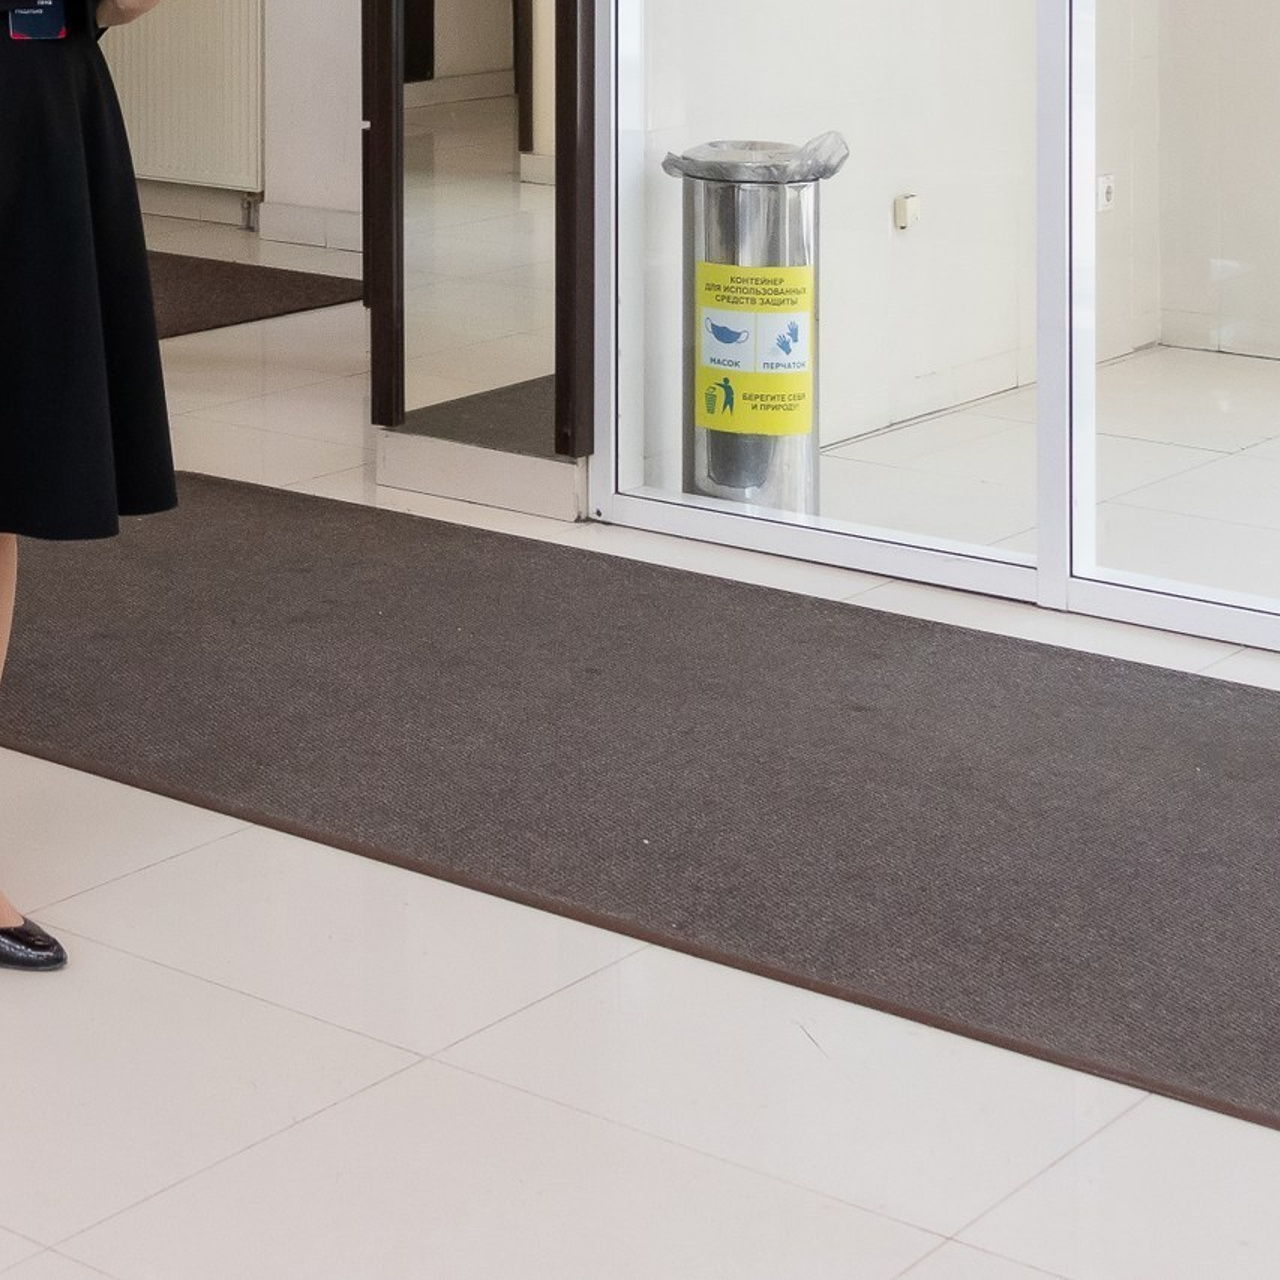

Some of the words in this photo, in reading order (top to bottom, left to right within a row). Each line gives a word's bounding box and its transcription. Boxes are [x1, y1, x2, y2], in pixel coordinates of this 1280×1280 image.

[730, 276, 785, 286] КОНТЕЙНЕР
[705, 283, 721, 291] ДЛЯ
[715, 295, 756, 305] СРЕДСТВ
[759, 297, 798, 306] ЗАЩИТЫ
[710, 357, 741, 368] МАСОК
[763, 361, 806, 370] ПЕРЧАТОК
[742, 393, 786, 402] БЕРЕГИТЕ
[751, 402, 758, 410] И
